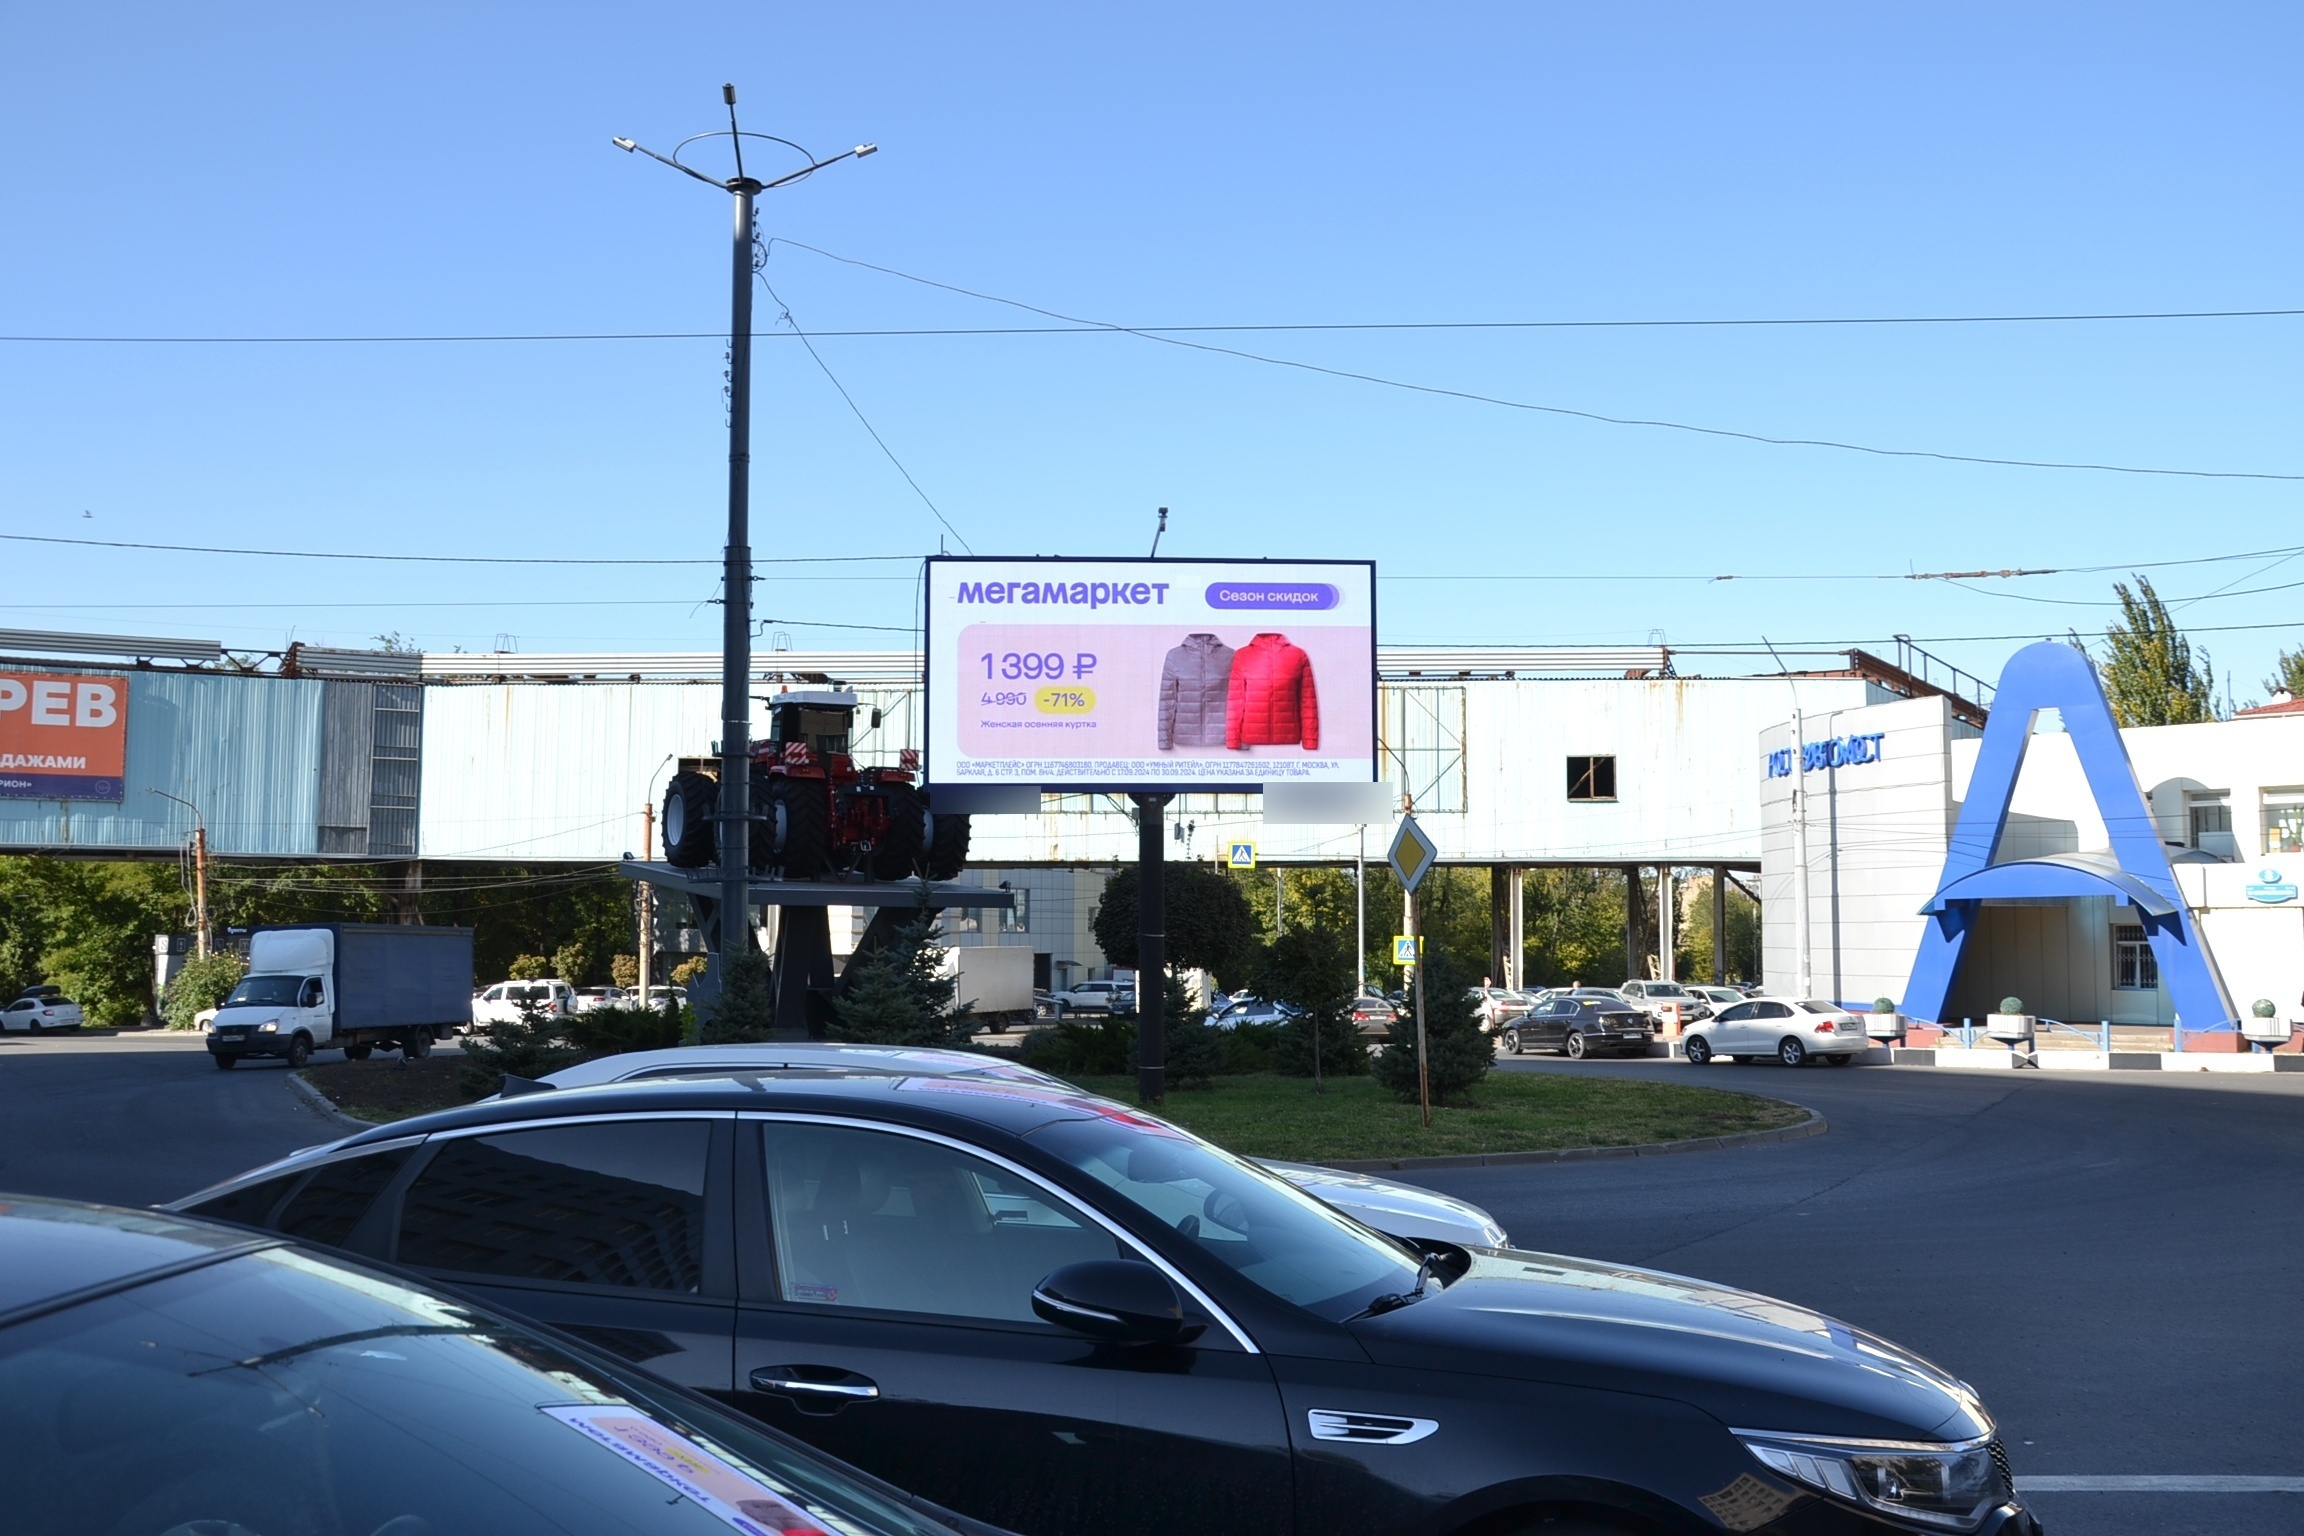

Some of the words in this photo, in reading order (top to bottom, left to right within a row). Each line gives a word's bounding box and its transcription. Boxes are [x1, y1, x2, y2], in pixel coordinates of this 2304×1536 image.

[957, 581, 1170, 610] мегамаркет
[1219, 589, 1265, 602] Сезон
[1267, 592, 1319, 604] скидок
[1043, 692, 1086, 707] -71%
[980, 720, 1022, 729] Женская
[1024, 721, 1063, 729] осенняя
[1065, 721, 1097, 730] куртка
[0, 753, 86, 769] ДАЖАМИ
